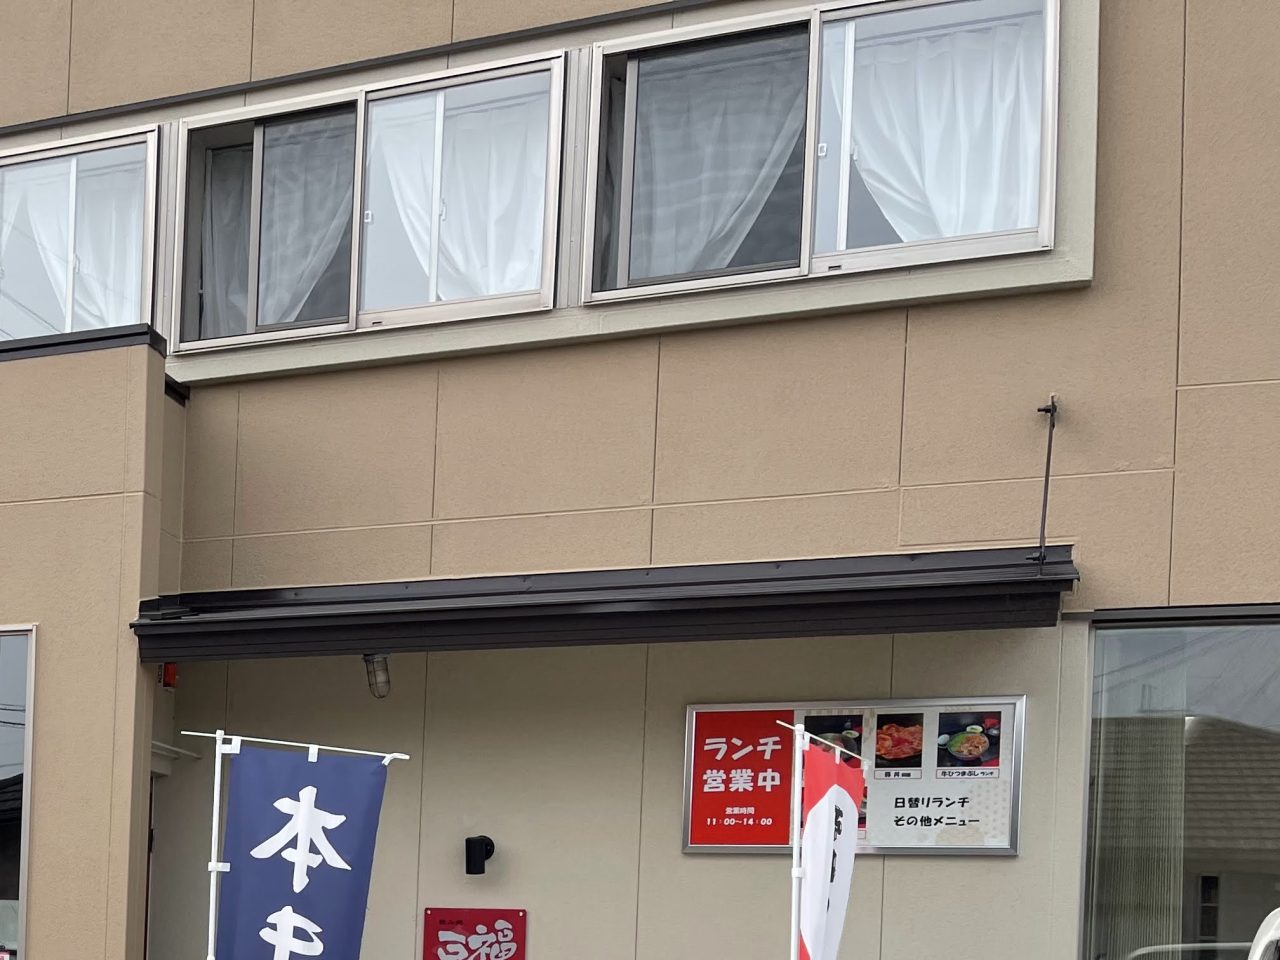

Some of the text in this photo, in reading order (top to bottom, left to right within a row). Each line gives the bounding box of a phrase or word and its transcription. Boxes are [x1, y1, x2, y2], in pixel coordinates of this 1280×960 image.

[704, 736, 782, 760] ランチ
[703, 768, 781, 792] 営業中
[894, 796, 970, 808] 日替りランチ
[893, 815, 980, 827] その他メニュー
